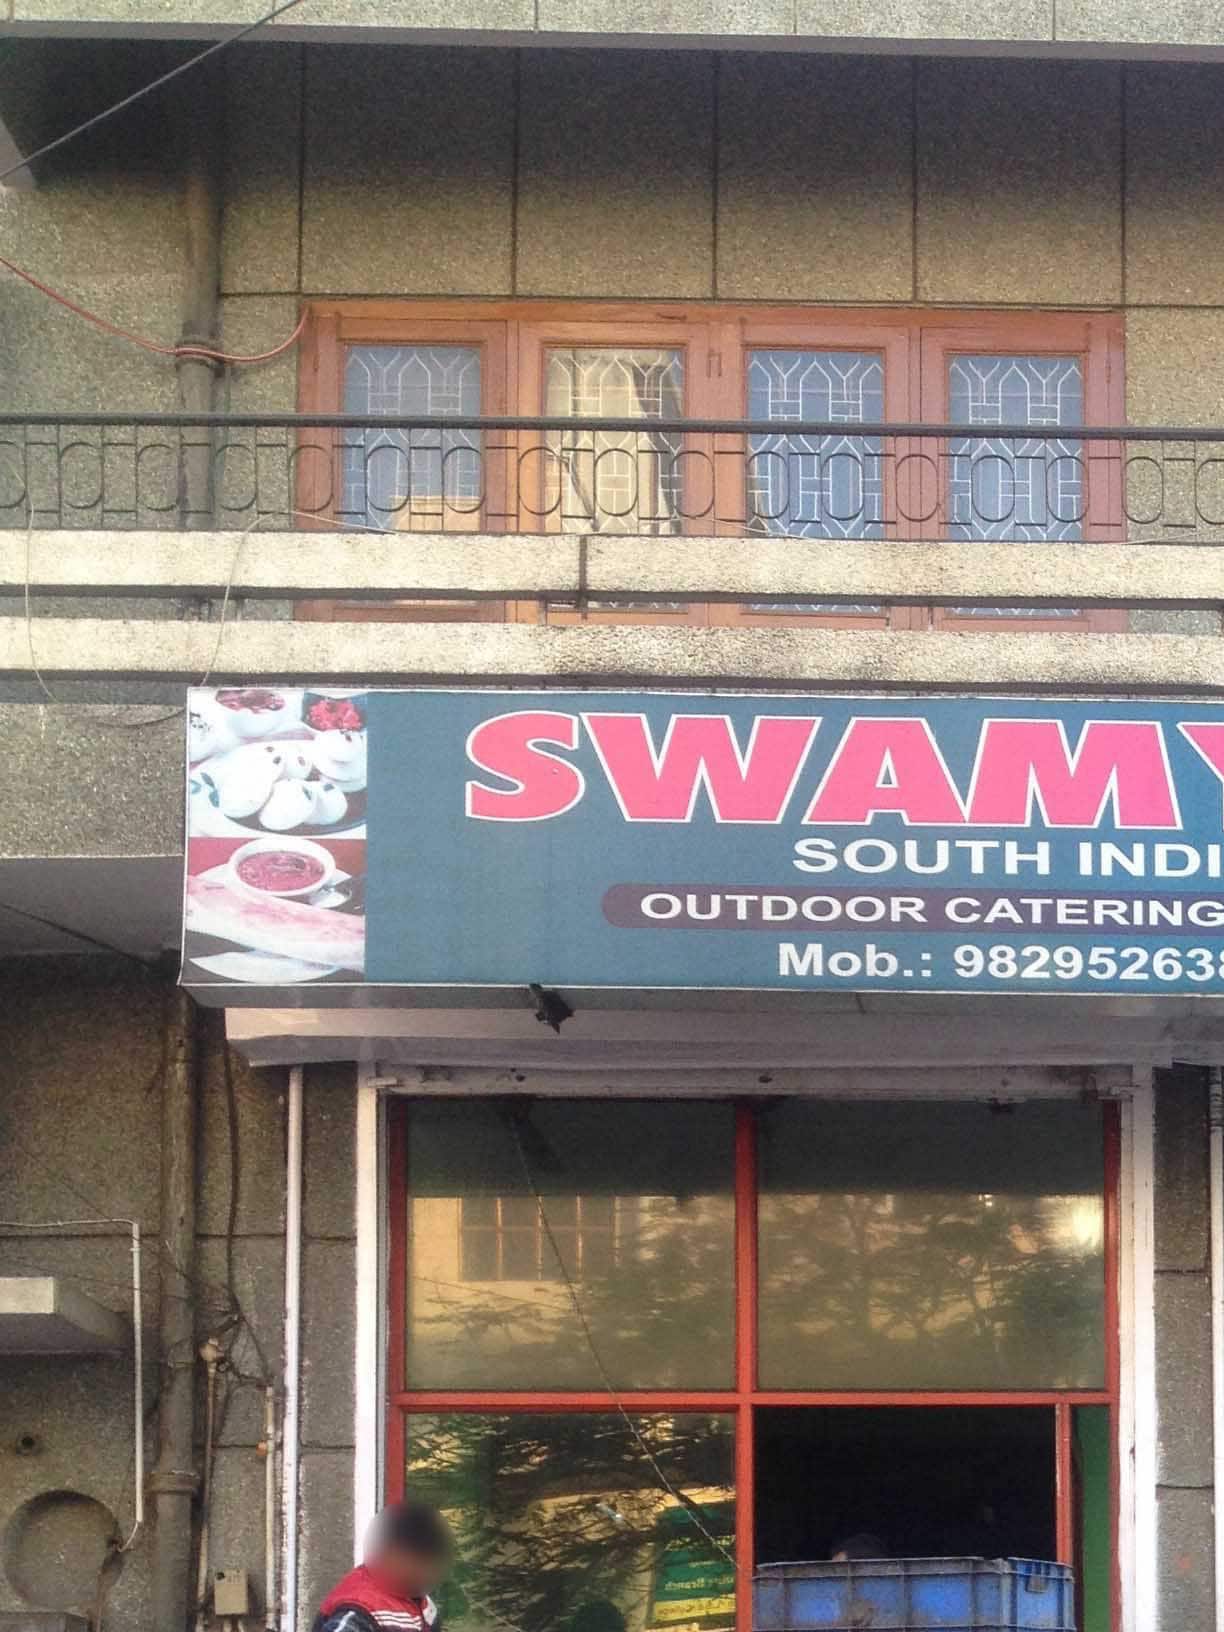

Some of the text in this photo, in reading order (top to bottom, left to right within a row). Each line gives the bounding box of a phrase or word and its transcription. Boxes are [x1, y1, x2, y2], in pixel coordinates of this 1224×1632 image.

[792, 838, 1051, 877] SOUTH
[640, 893, 927, 926] OUTDOOR
[778, 943, 932, 979] Mob.:
